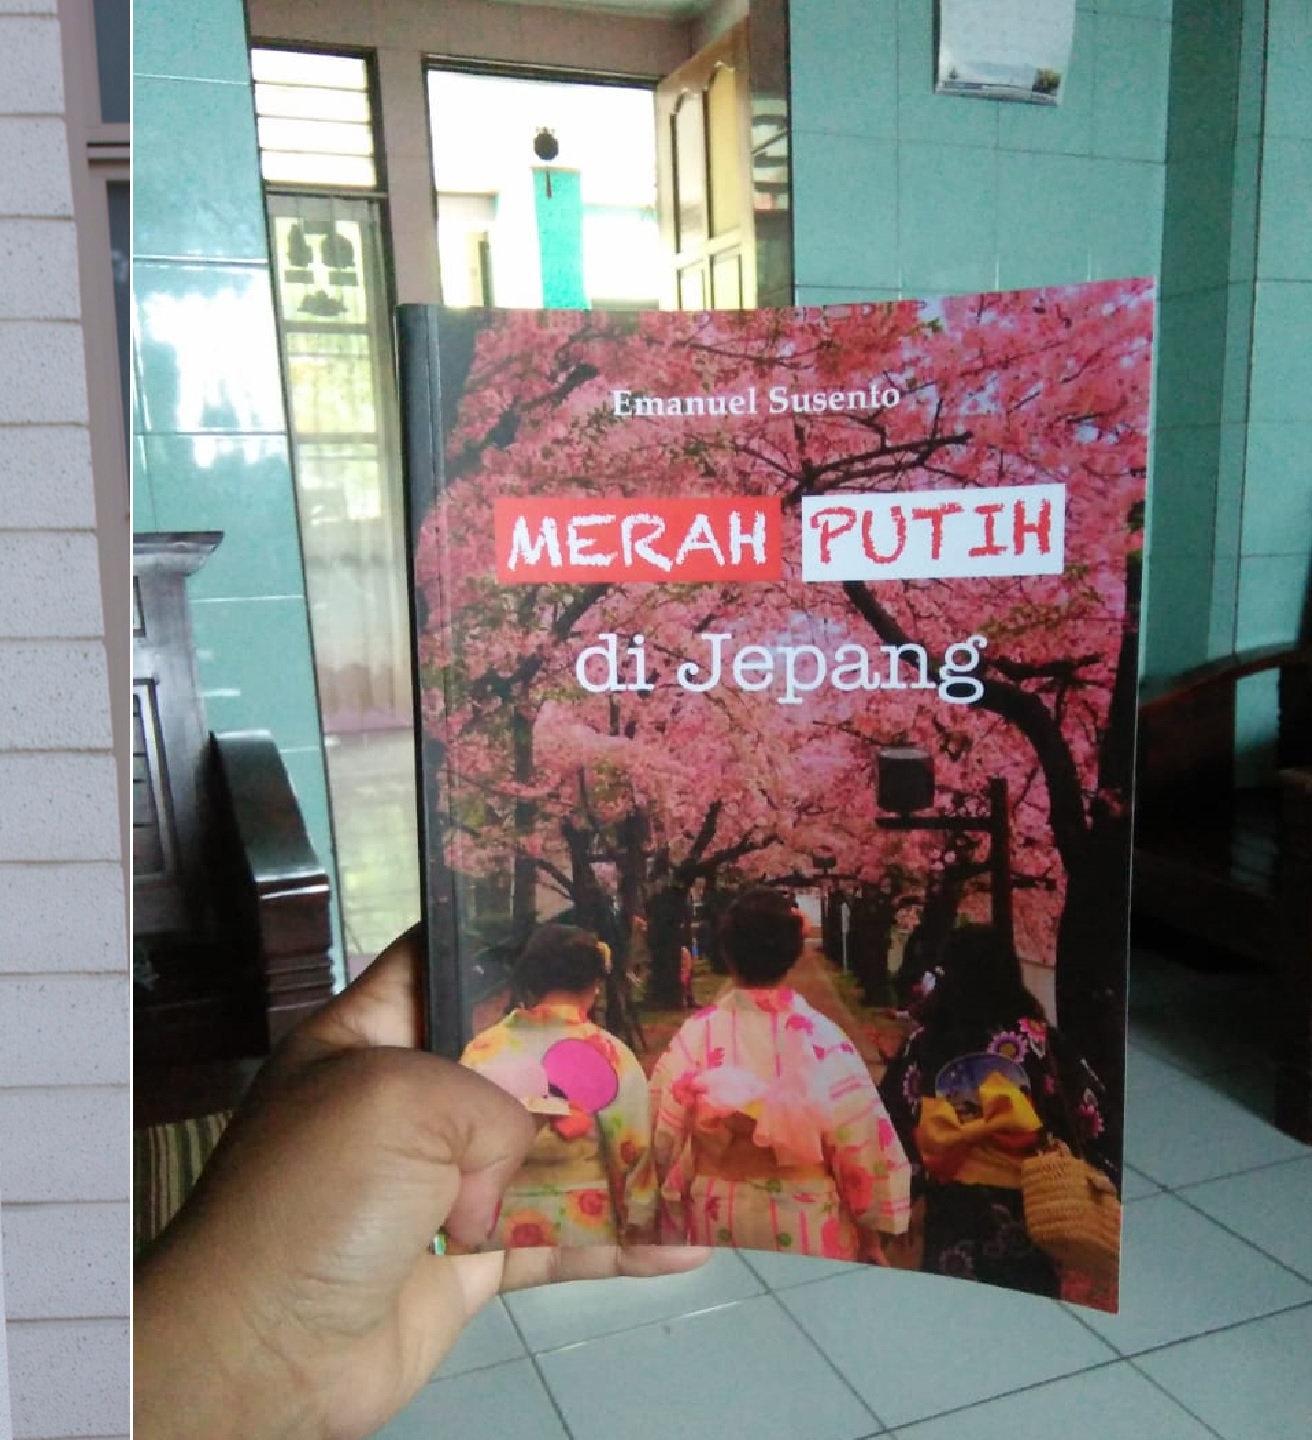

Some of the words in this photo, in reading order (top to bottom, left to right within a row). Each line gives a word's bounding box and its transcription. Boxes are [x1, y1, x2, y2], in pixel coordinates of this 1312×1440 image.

[613, 387, 758, 417] Emanuel
[768, 384, 901, 414] Susento
[507, 510, 769, 573] MERAH
[809, 496, 1053, 566] PUTIH
[575, 633, 654, 694] di
[675, 632, 989, 704] Jepang
